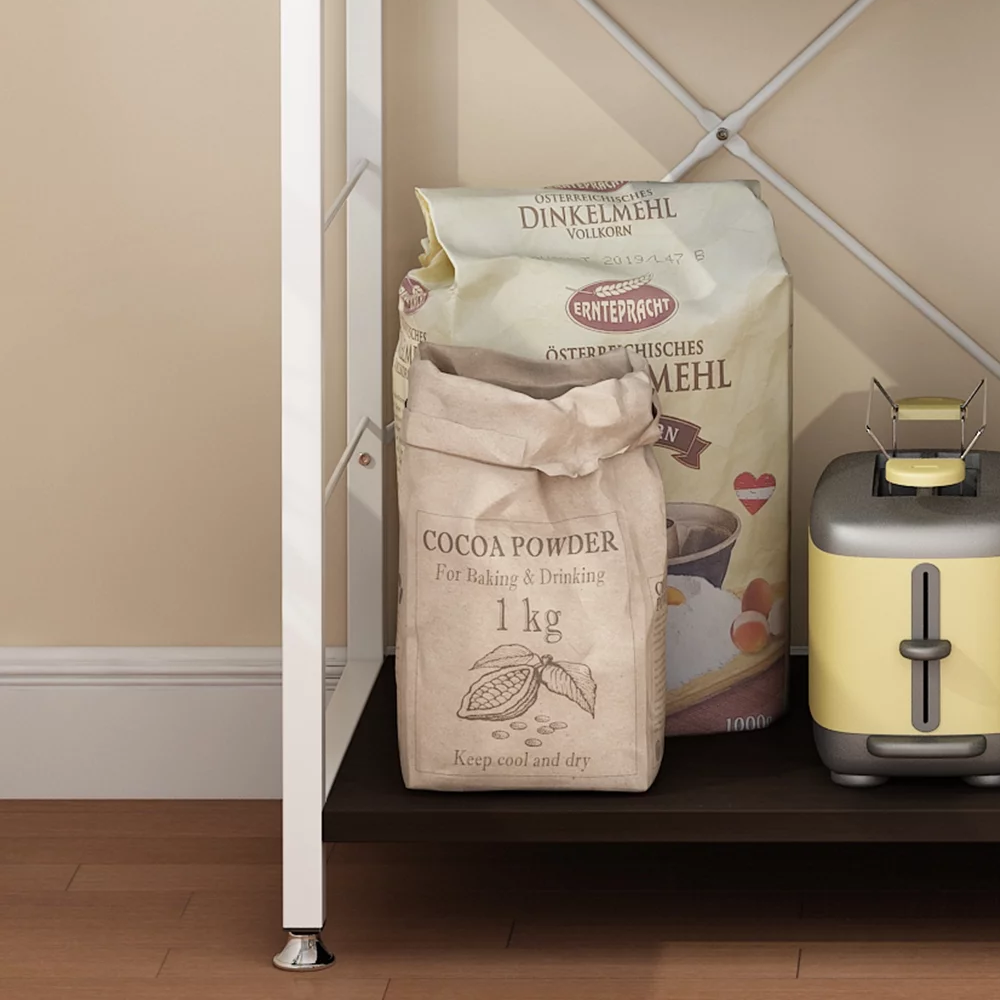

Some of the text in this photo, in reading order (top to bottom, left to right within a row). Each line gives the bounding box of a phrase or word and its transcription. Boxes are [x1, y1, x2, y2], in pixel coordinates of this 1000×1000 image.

[517, 198, 677, 230] DINKELMEHL
[566, 225, 633, 240] VOLLKORN
[573, 298, 671, 325] ERNTEPRACHT
[649, 359, 732, 393] MEHL
[423, 529, 619, 557] COCOA POWDER
[435, 563, 606, 591] For Baking & Drinking
[497, 597, 563, 644] 1 kg
[454, 750, 592, 772] Keep cool and dry
